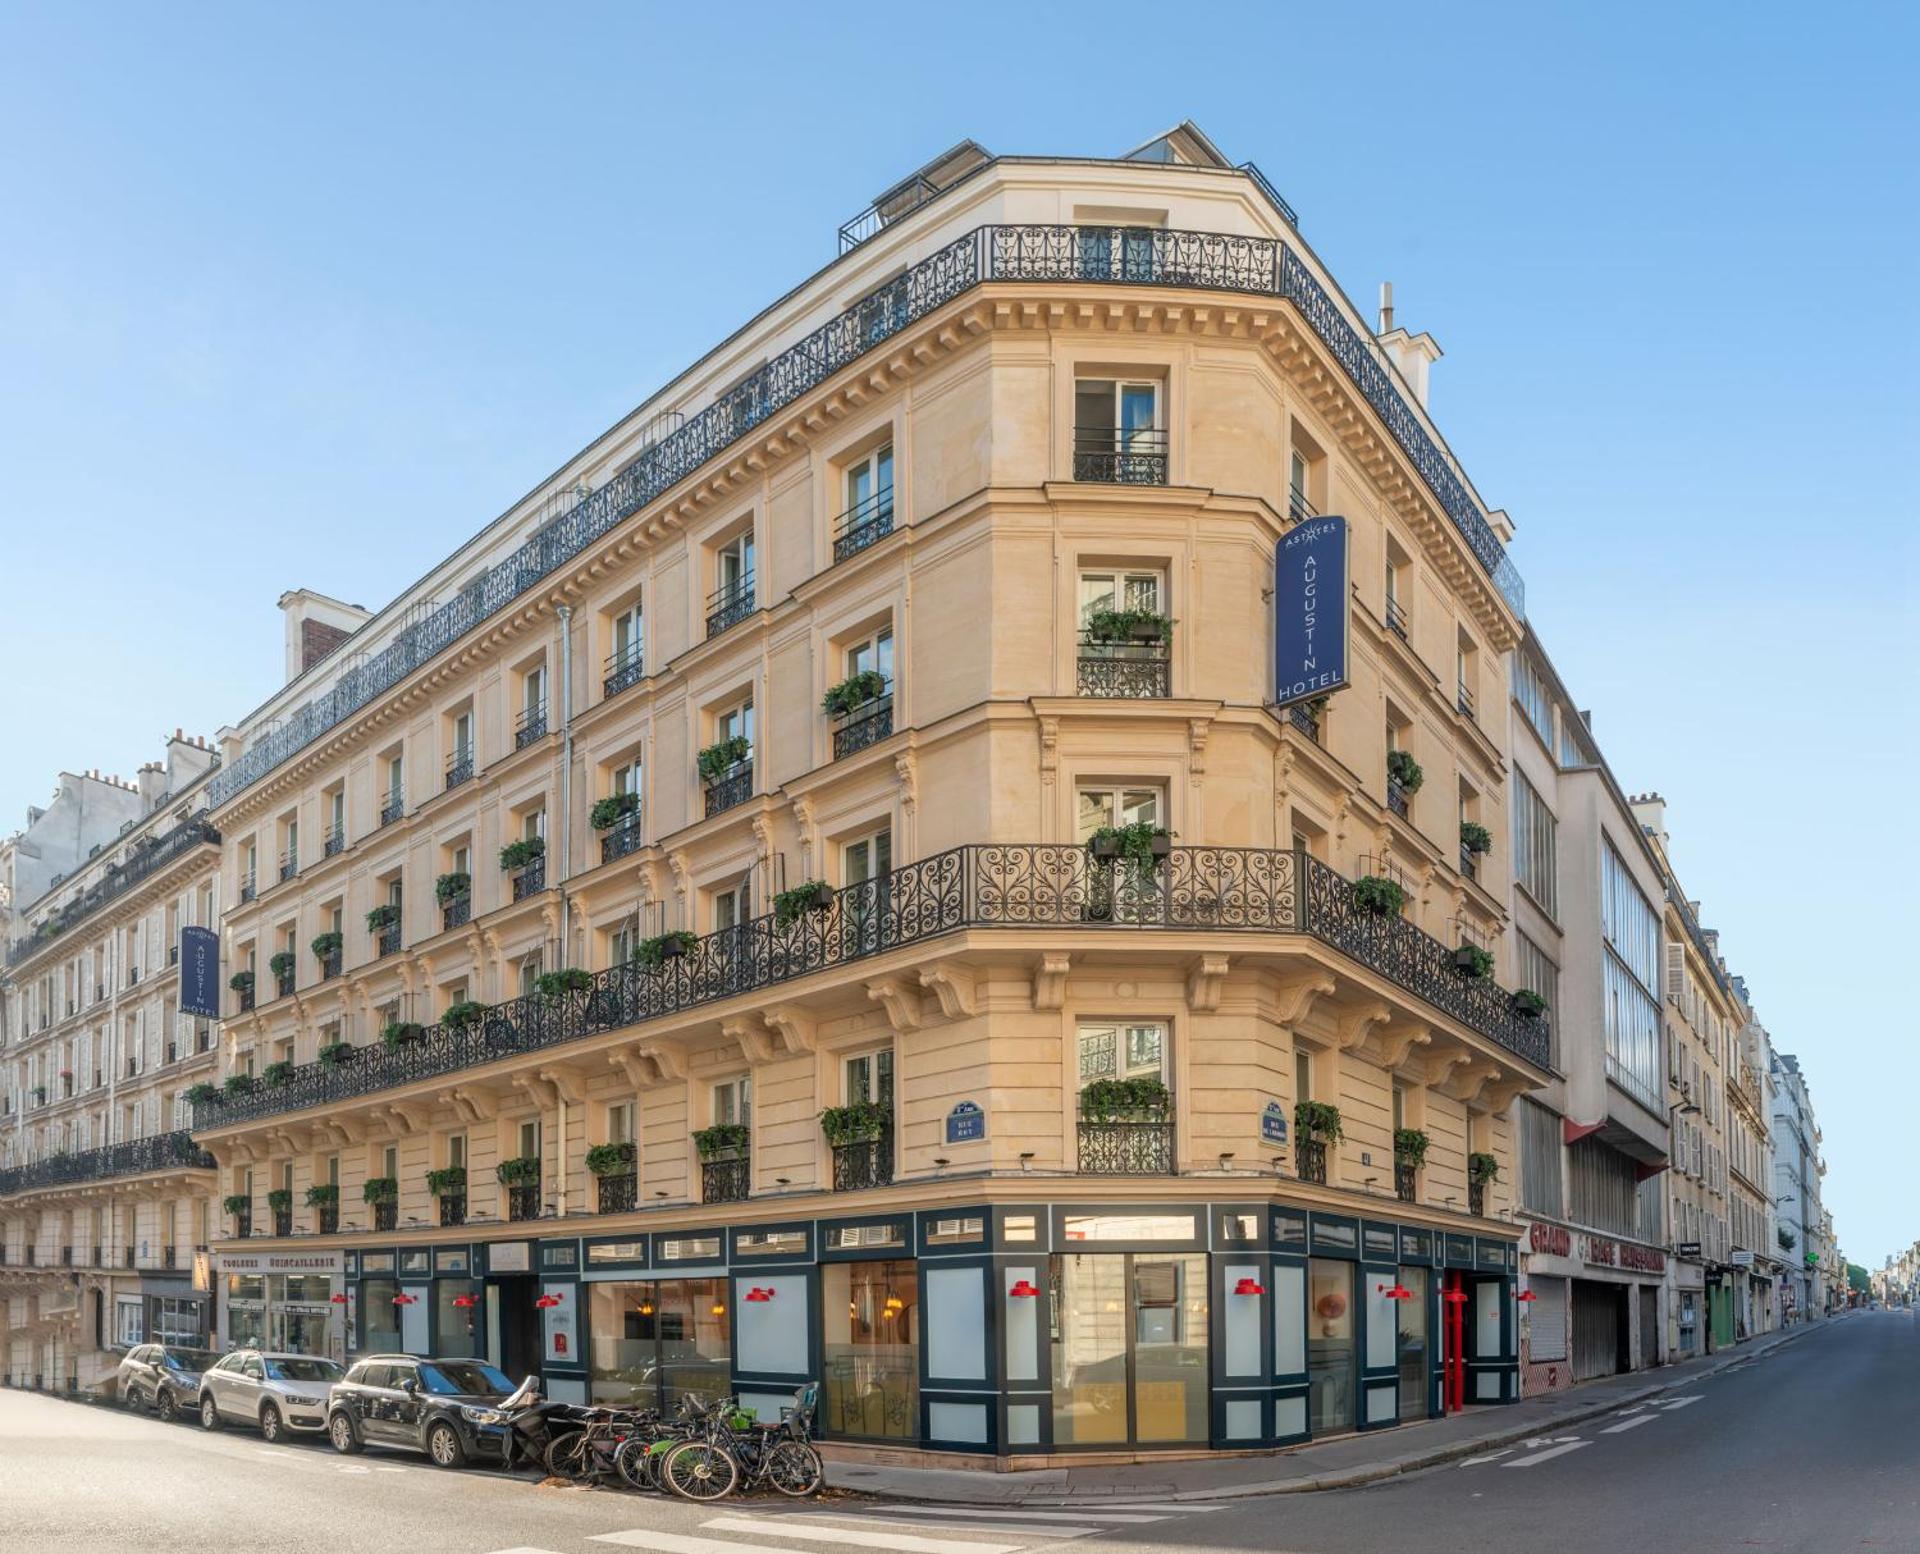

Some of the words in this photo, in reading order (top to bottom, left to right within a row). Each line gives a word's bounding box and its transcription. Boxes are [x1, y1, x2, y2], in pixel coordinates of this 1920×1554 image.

[1303, 555, 1317, 672] AUGUSTIN
[1279, 670, 1342, 701] HOTEL
[196, 945, 206, 1004] AUGUSTIN
[182, 1003, 216, 1017] HOTEL
[1530, 1222, 1571, 1258] GRAND
[1578, 1233, 1615, 1266] GARAGE
